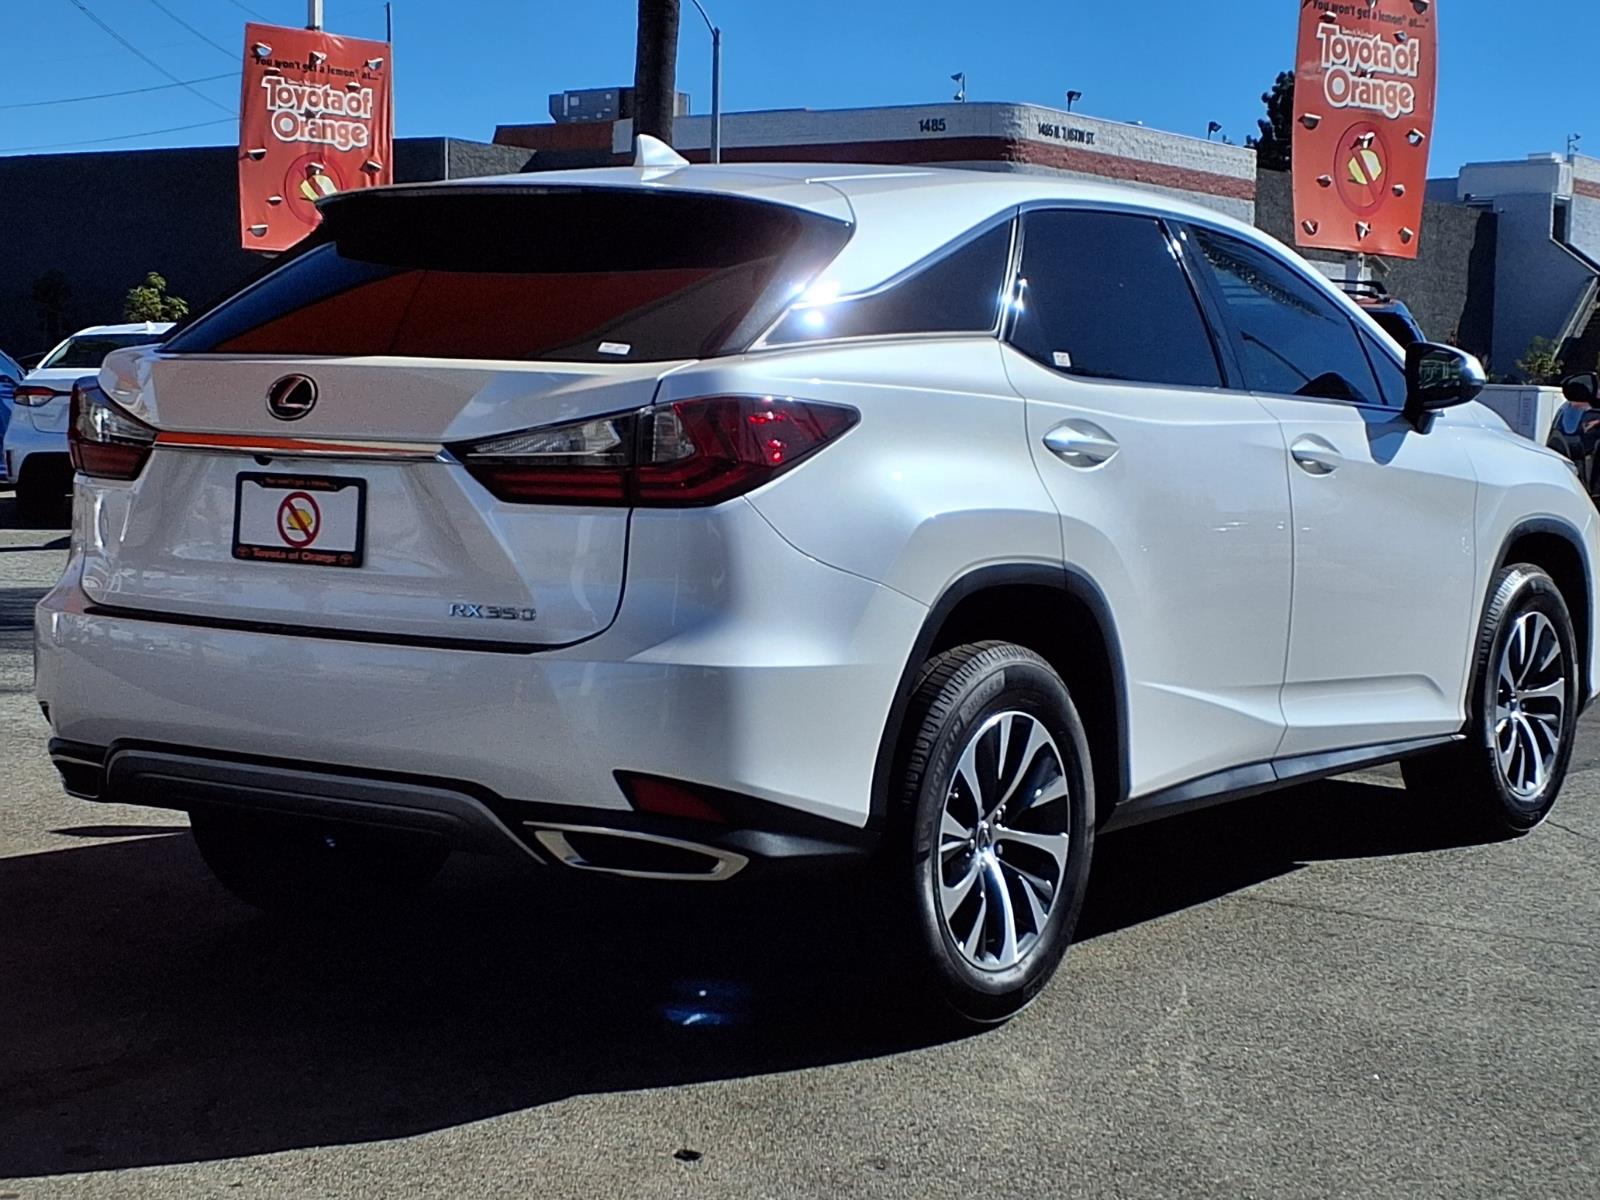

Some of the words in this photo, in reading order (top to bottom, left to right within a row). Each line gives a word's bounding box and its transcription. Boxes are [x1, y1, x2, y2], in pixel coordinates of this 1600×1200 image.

[1324, 65, 1414, 119] Orange
[271, 108, 368, 151] Orange
[918, 118, 946, 133] 1485
[1037, 121, 1054, 137] 1485
